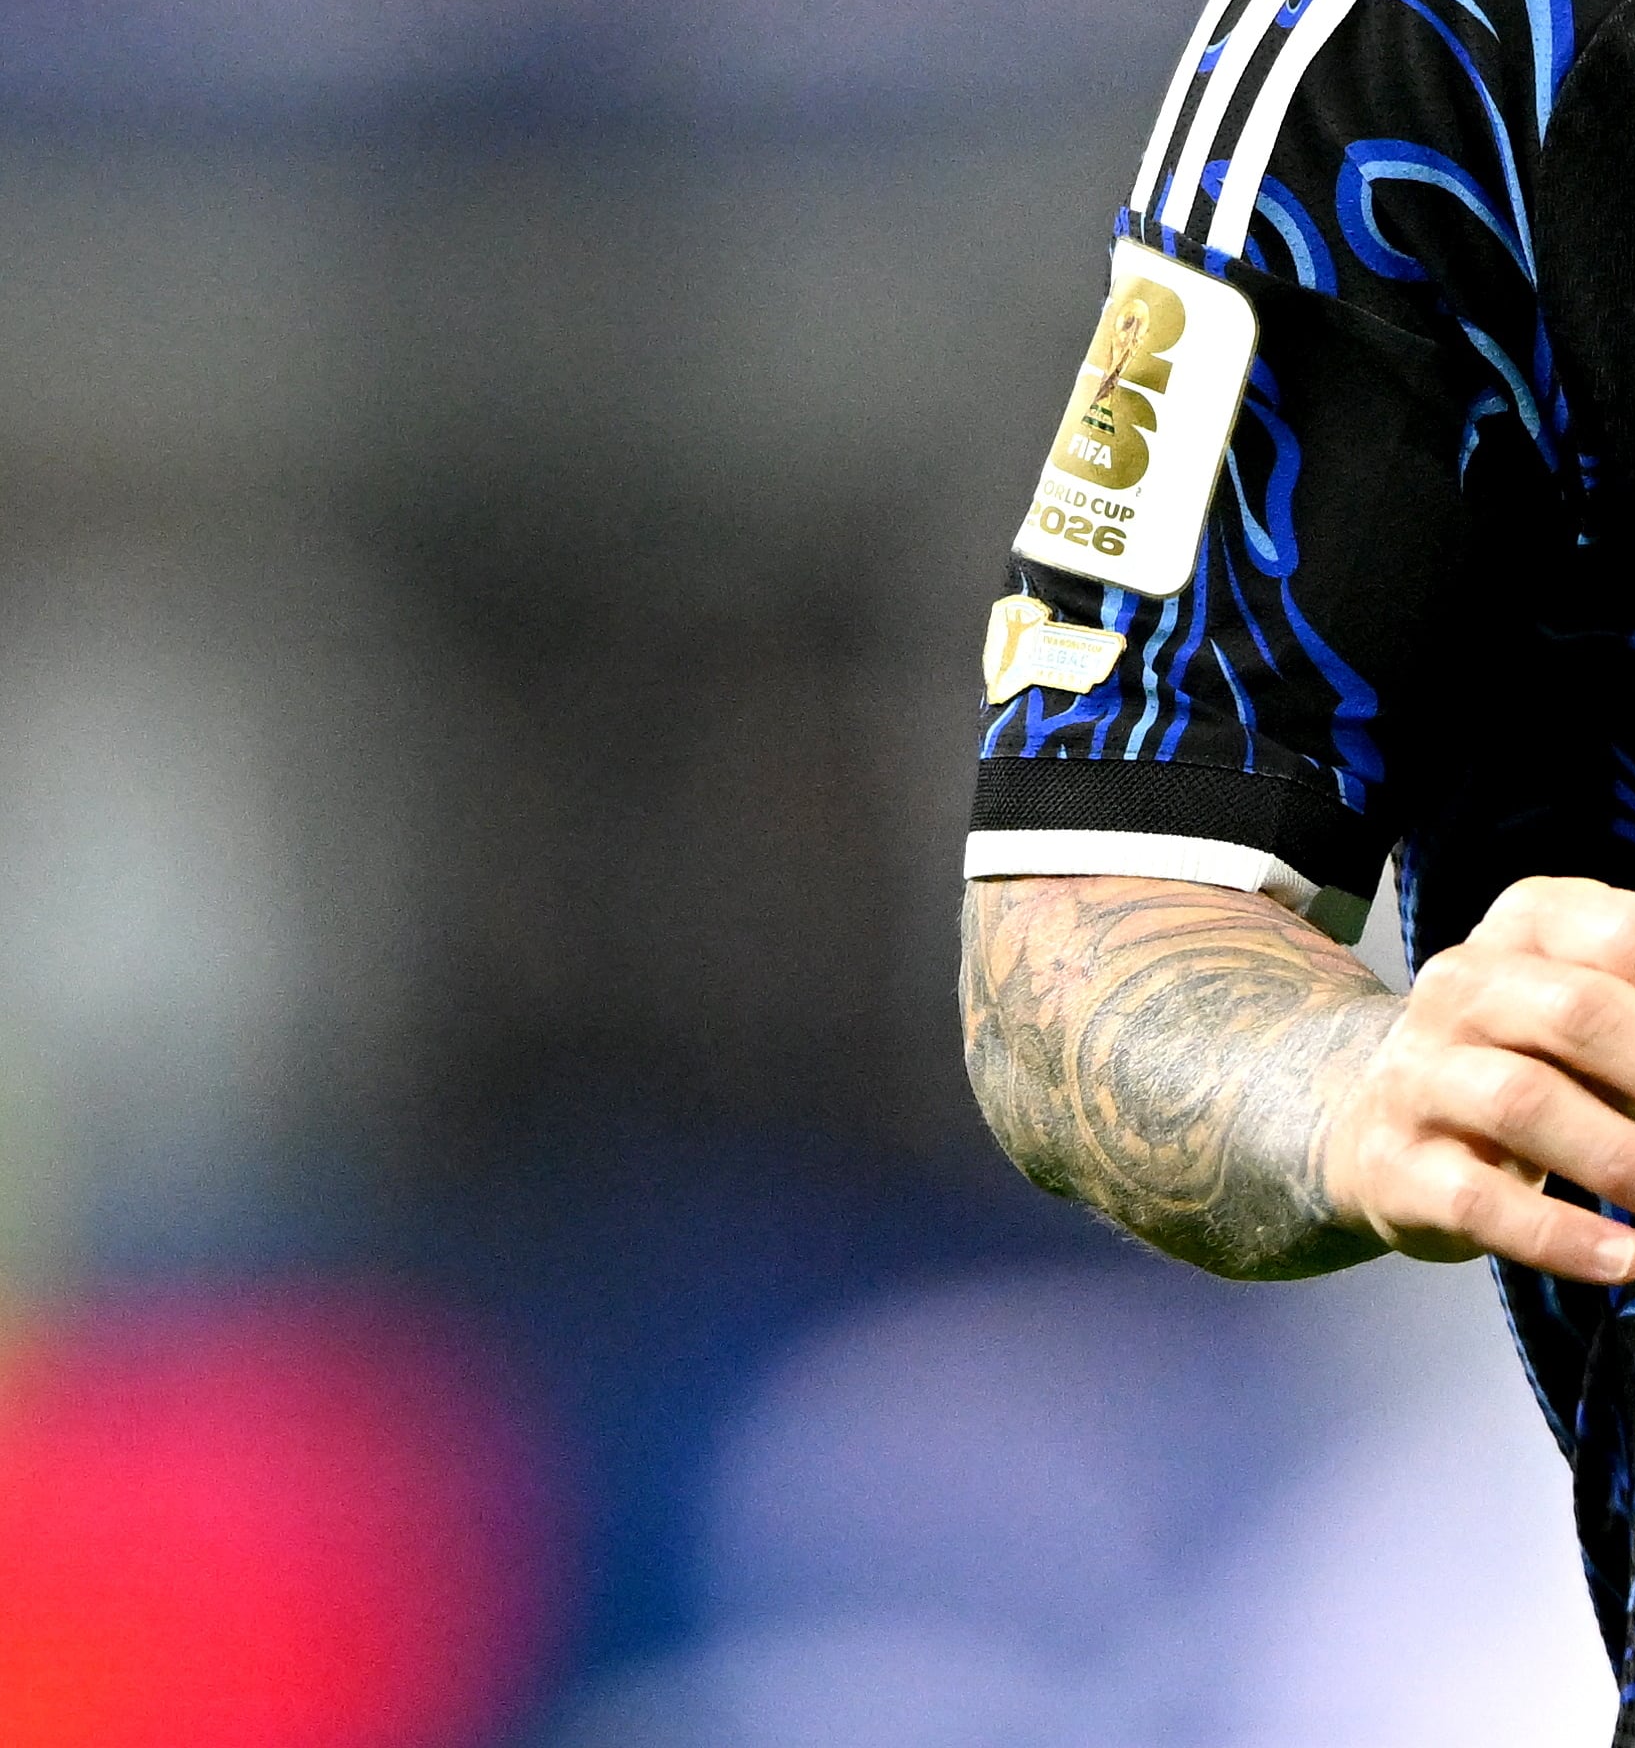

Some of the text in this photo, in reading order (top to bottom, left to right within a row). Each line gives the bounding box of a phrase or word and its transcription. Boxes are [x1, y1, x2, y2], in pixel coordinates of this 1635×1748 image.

[1068, 433, 1112, 469] FIFA
[1043, 479, 1135, 522] ORLD CUP
